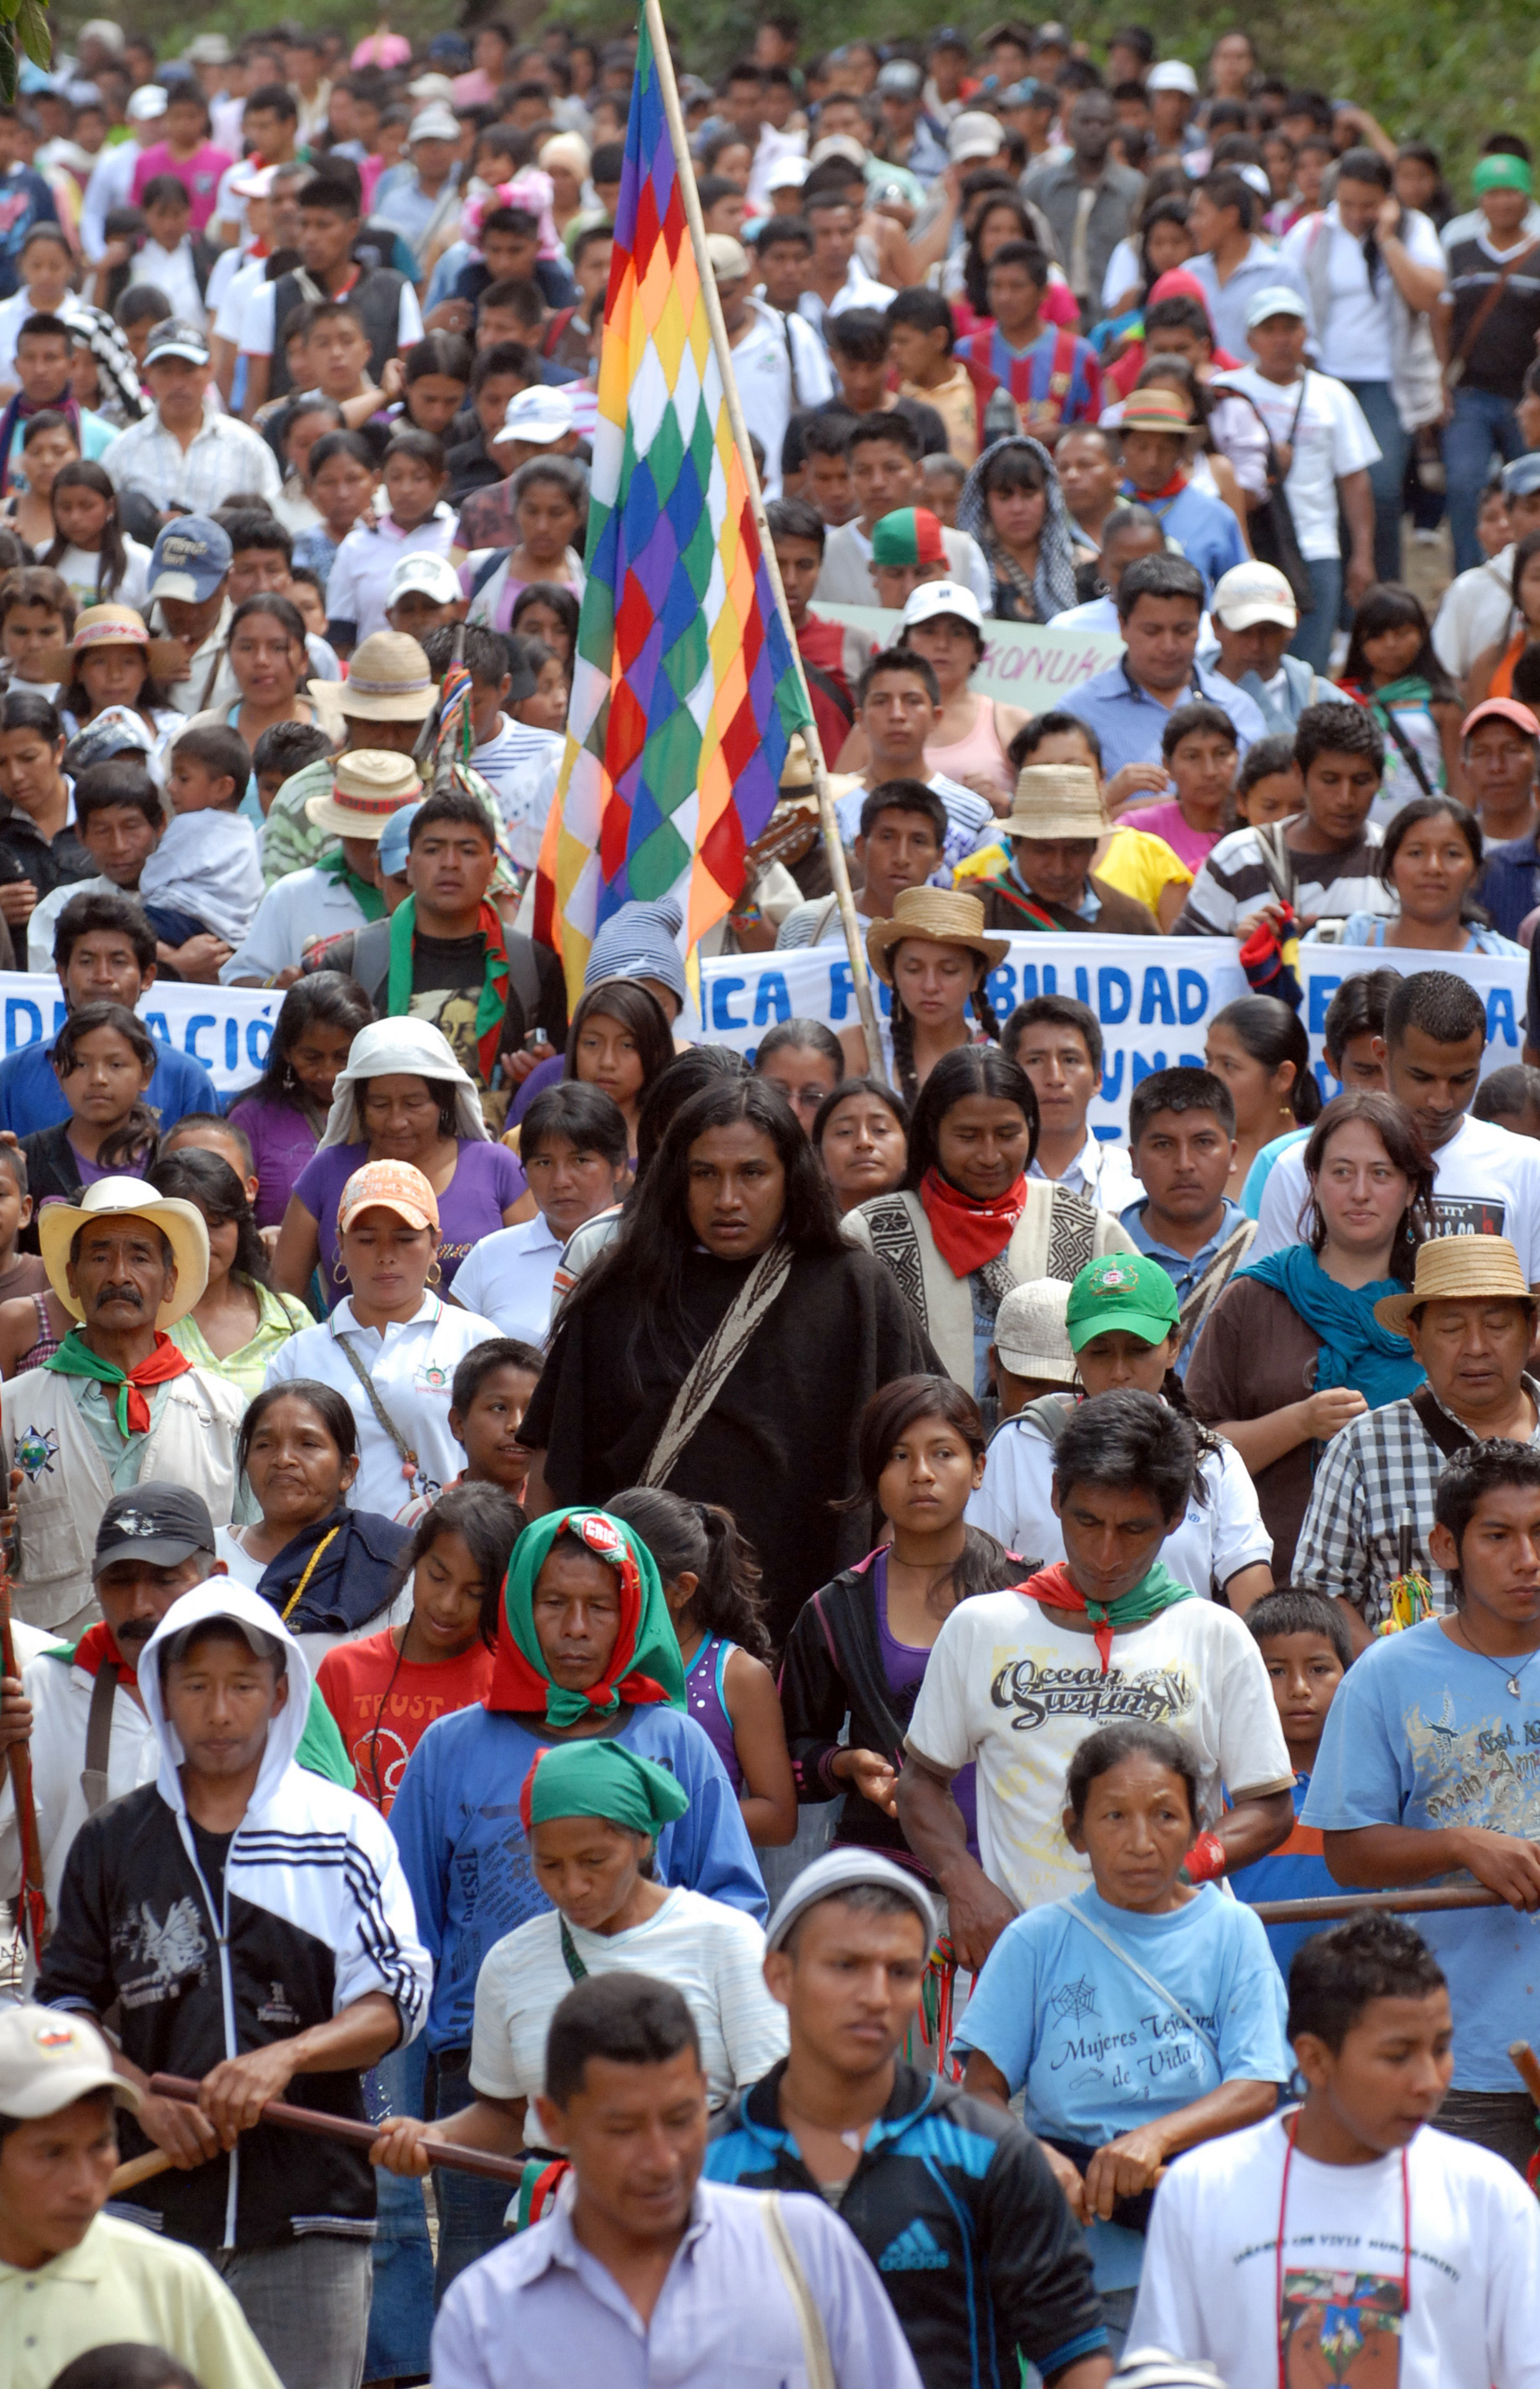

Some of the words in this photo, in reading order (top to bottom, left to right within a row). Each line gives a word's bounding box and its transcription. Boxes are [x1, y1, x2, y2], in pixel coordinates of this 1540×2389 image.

[982, 638, 1118, 686] KONUK
[353, 1694, 445, 1720] TRUST
[991, 1660, 1127, 1711] Ocean
[455, 1847, 480, 1924] DIESEL
[1051, 2028, 1137, 2071] Mujeres
[1112, 2063, 1131, 2088] de
[1136, 2044, 1192, 2078] Vida
